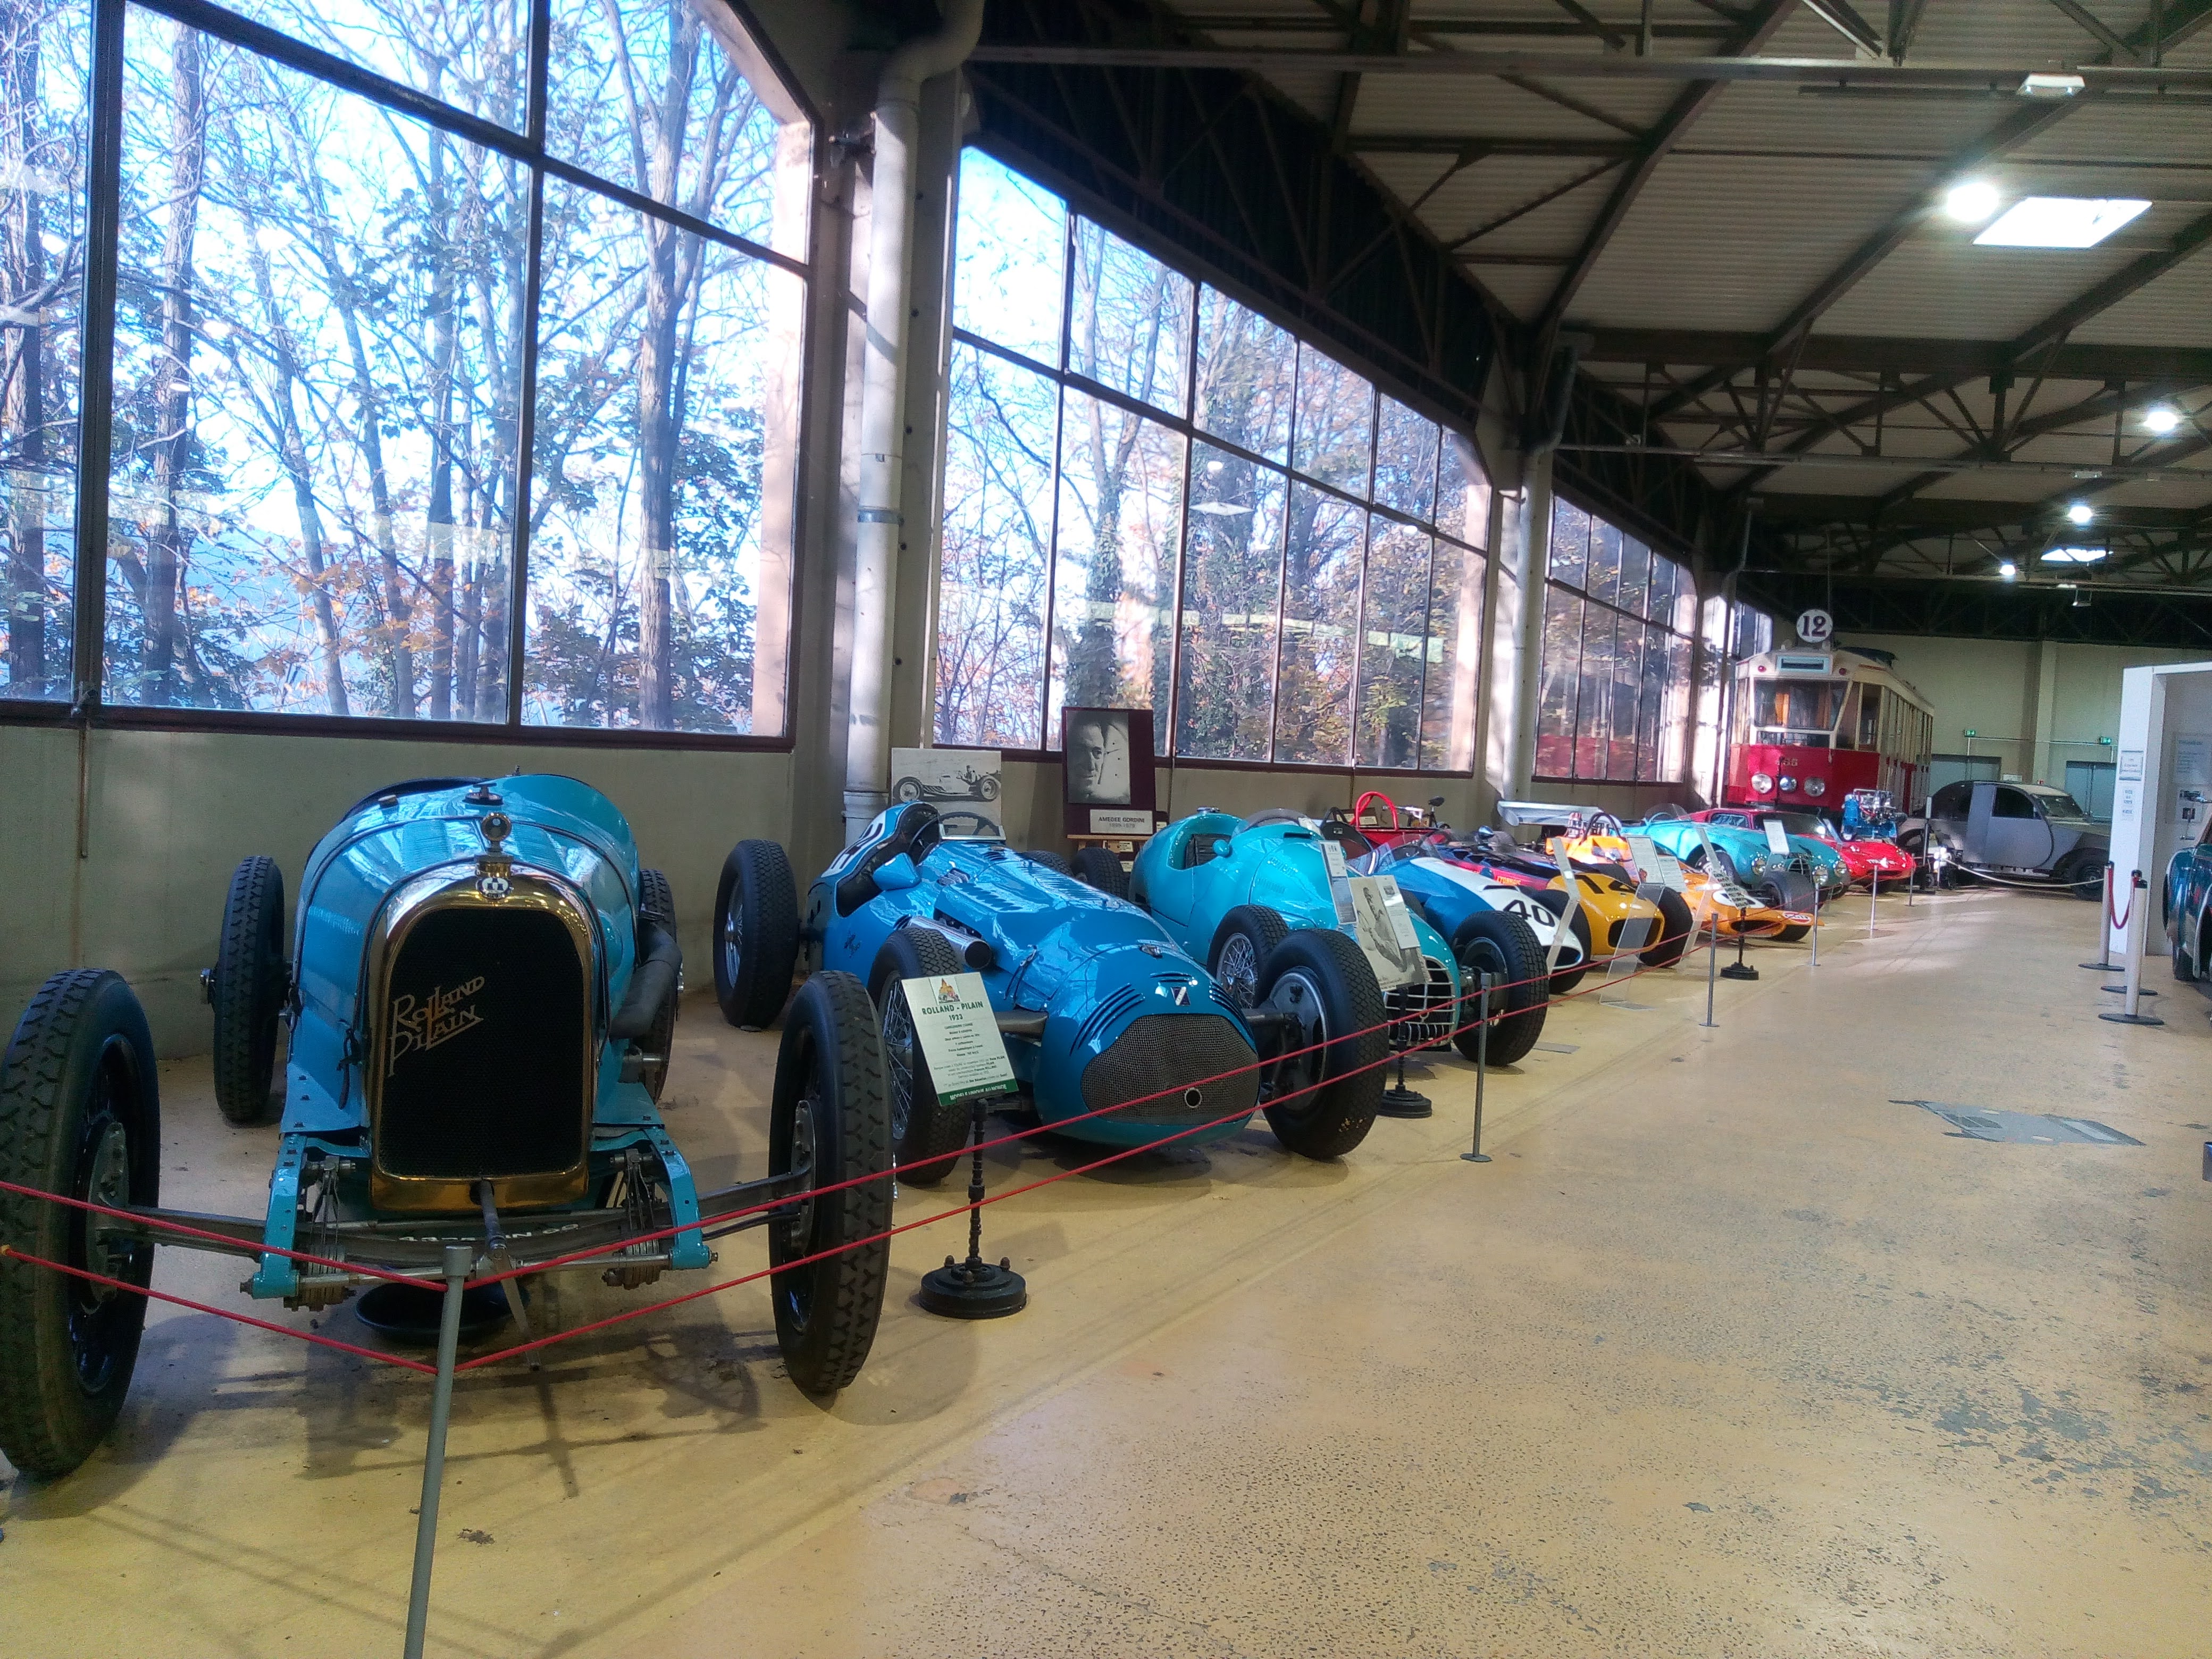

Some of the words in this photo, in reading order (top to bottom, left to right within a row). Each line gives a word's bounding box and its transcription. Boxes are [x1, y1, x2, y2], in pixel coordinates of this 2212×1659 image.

[1802, 615, 1826, 637] 12
[1503, 899, 1555, 927] 40
[921, 1004, 954, 1015] ROLLAND
[960, 1001, 984, 1010] PILAIN
